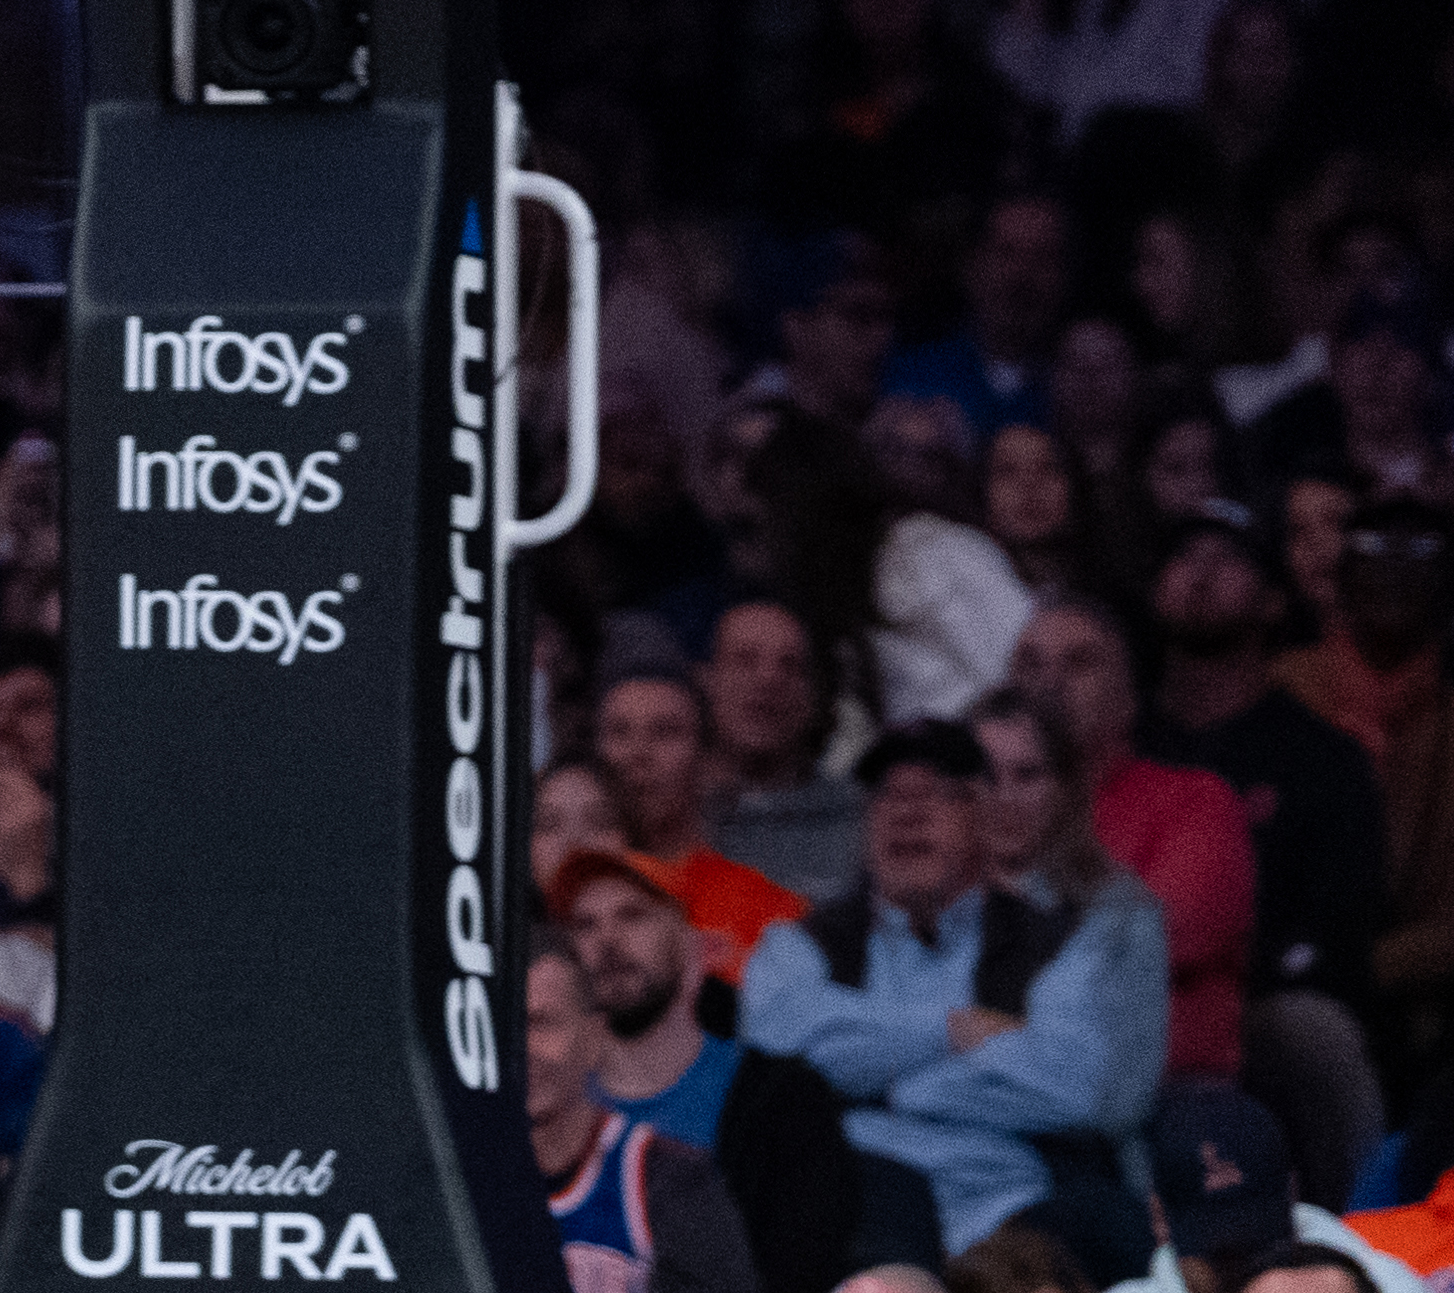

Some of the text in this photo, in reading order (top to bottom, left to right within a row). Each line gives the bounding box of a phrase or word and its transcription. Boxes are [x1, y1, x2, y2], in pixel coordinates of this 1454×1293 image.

[124, 315, 350, 406] Infosys
[118, 435, 344, 526] Infosys
[118, 573, 346, 666] Infosys
[440, 255, 500, 1093] Spectrum
[103, 1138, 338, 1198] Michelob
[61, 1209, 398, 1281] ULTRA
